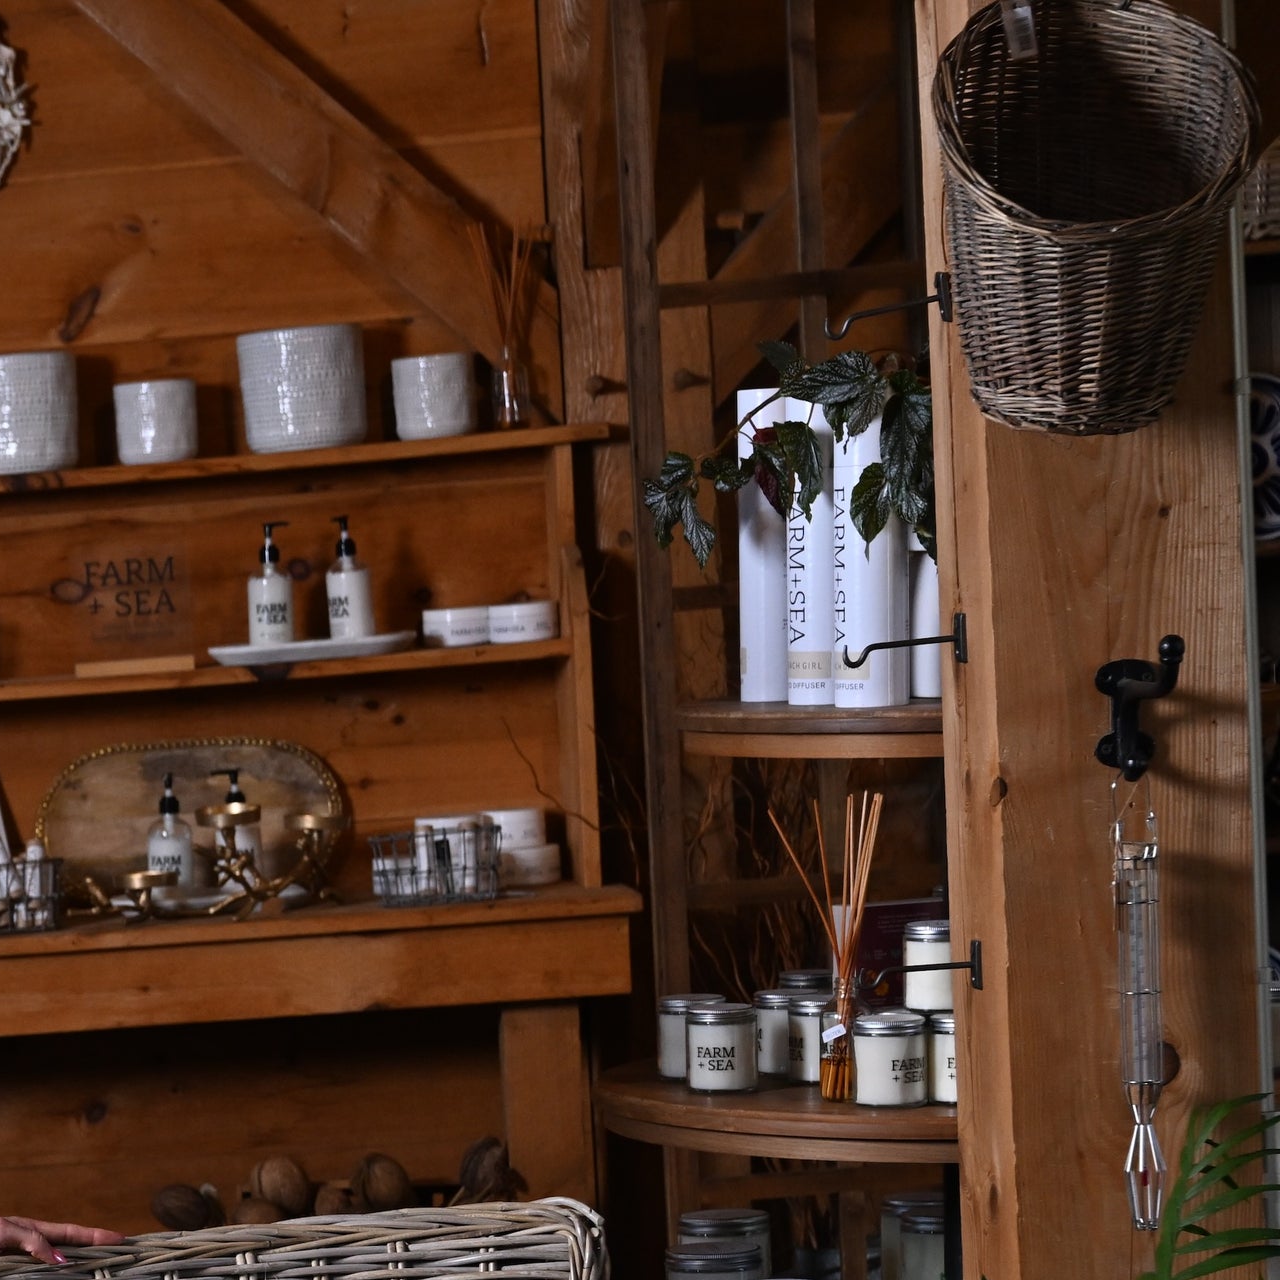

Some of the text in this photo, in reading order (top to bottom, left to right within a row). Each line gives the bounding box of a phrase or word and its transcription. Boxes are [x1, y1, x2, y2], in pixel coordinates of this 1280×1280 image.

[834, 486, 847, 644] FARM+SEA
[84, 556, 176, 588] FARM
[114, 588, 177, 618] SEA
[256, 602, 288, 615] FARM
[267, 613, 288, 626] SEA
[697, 1046, 736, 1059] FARM
[708, 1059, 736, 1071] SEA
[891, 1057, 926, 1071] FARM
[904, 1071, 926, 1084] SEA
